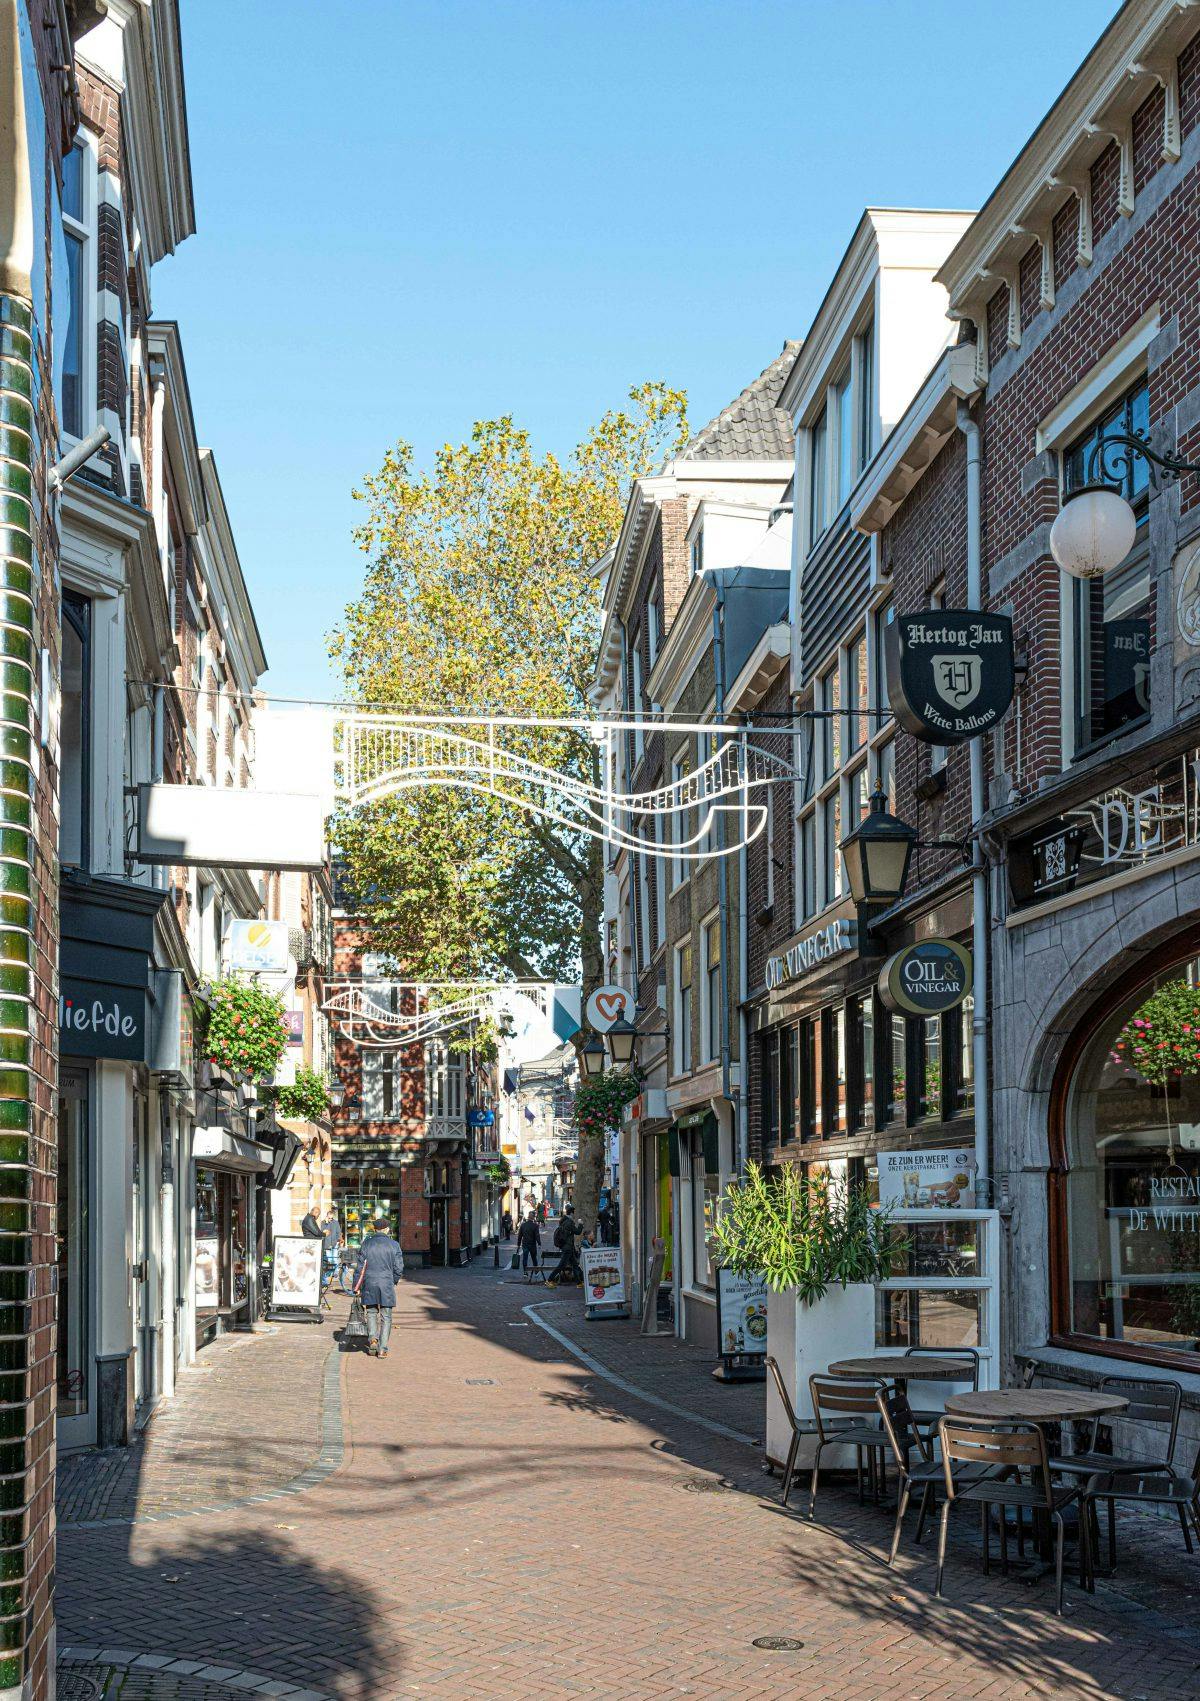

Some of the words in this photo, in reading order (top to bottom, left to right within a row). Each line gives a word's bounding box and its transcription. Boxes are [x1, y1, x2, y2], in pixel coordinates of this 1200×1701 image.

[907, 624, 967, 649] Hertog
[969, 624, 1003, 649] Jan
[923, 702, 952, 730] Witte
[955, 708, 996, 731] Ballons
[1101, 785, 1161, 866] DE
[906, 982, 960, 993] VINEGAR
[915, 1155, 924, 1164] ER
[925, 1154, 949, 1164] WEER!
[1130, 1208, 1148, 1231] DE
